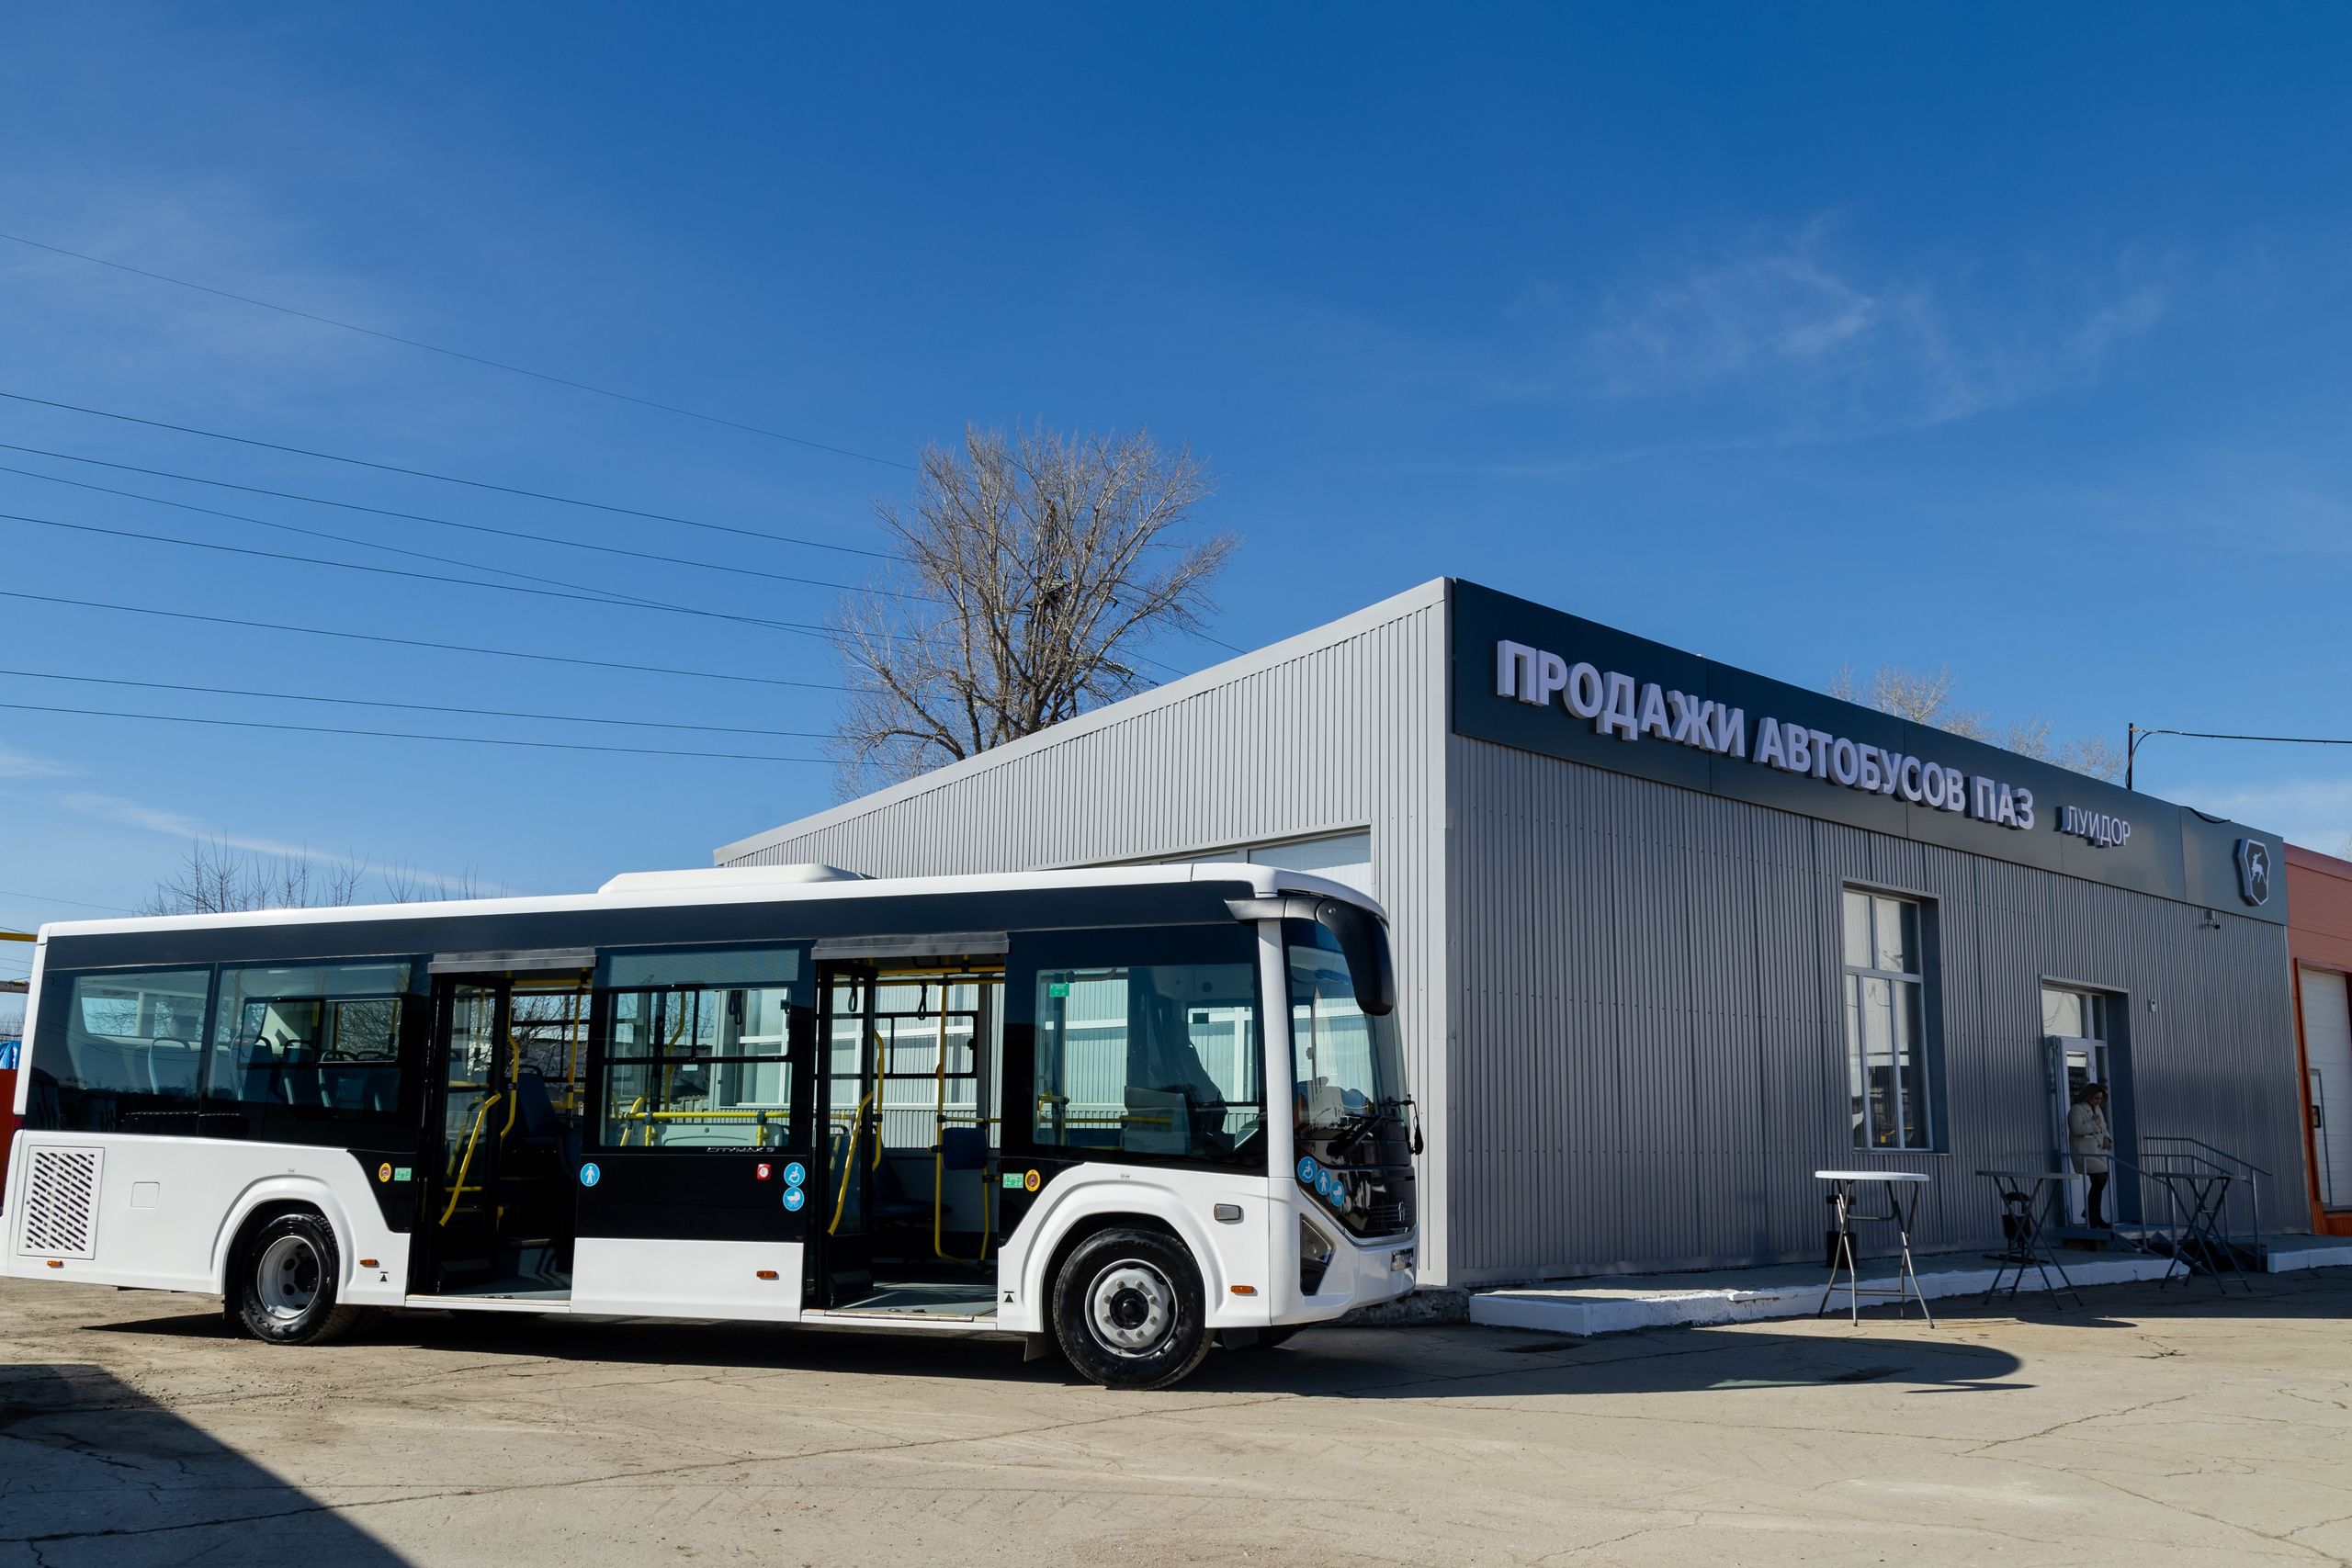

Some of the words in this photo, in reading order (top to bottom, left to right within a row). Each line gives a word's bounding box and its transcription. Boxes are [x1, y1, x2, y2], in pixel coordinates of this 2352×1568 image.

[1497, 639, 1746, 759] ПРОДАЖИ
[1752, 716, 1966, 812] АВТОБУСОВ
[1970, 775, 2035, 830] ПАЗ
[2062, 806, 2131, 848] ЛУИДОР
